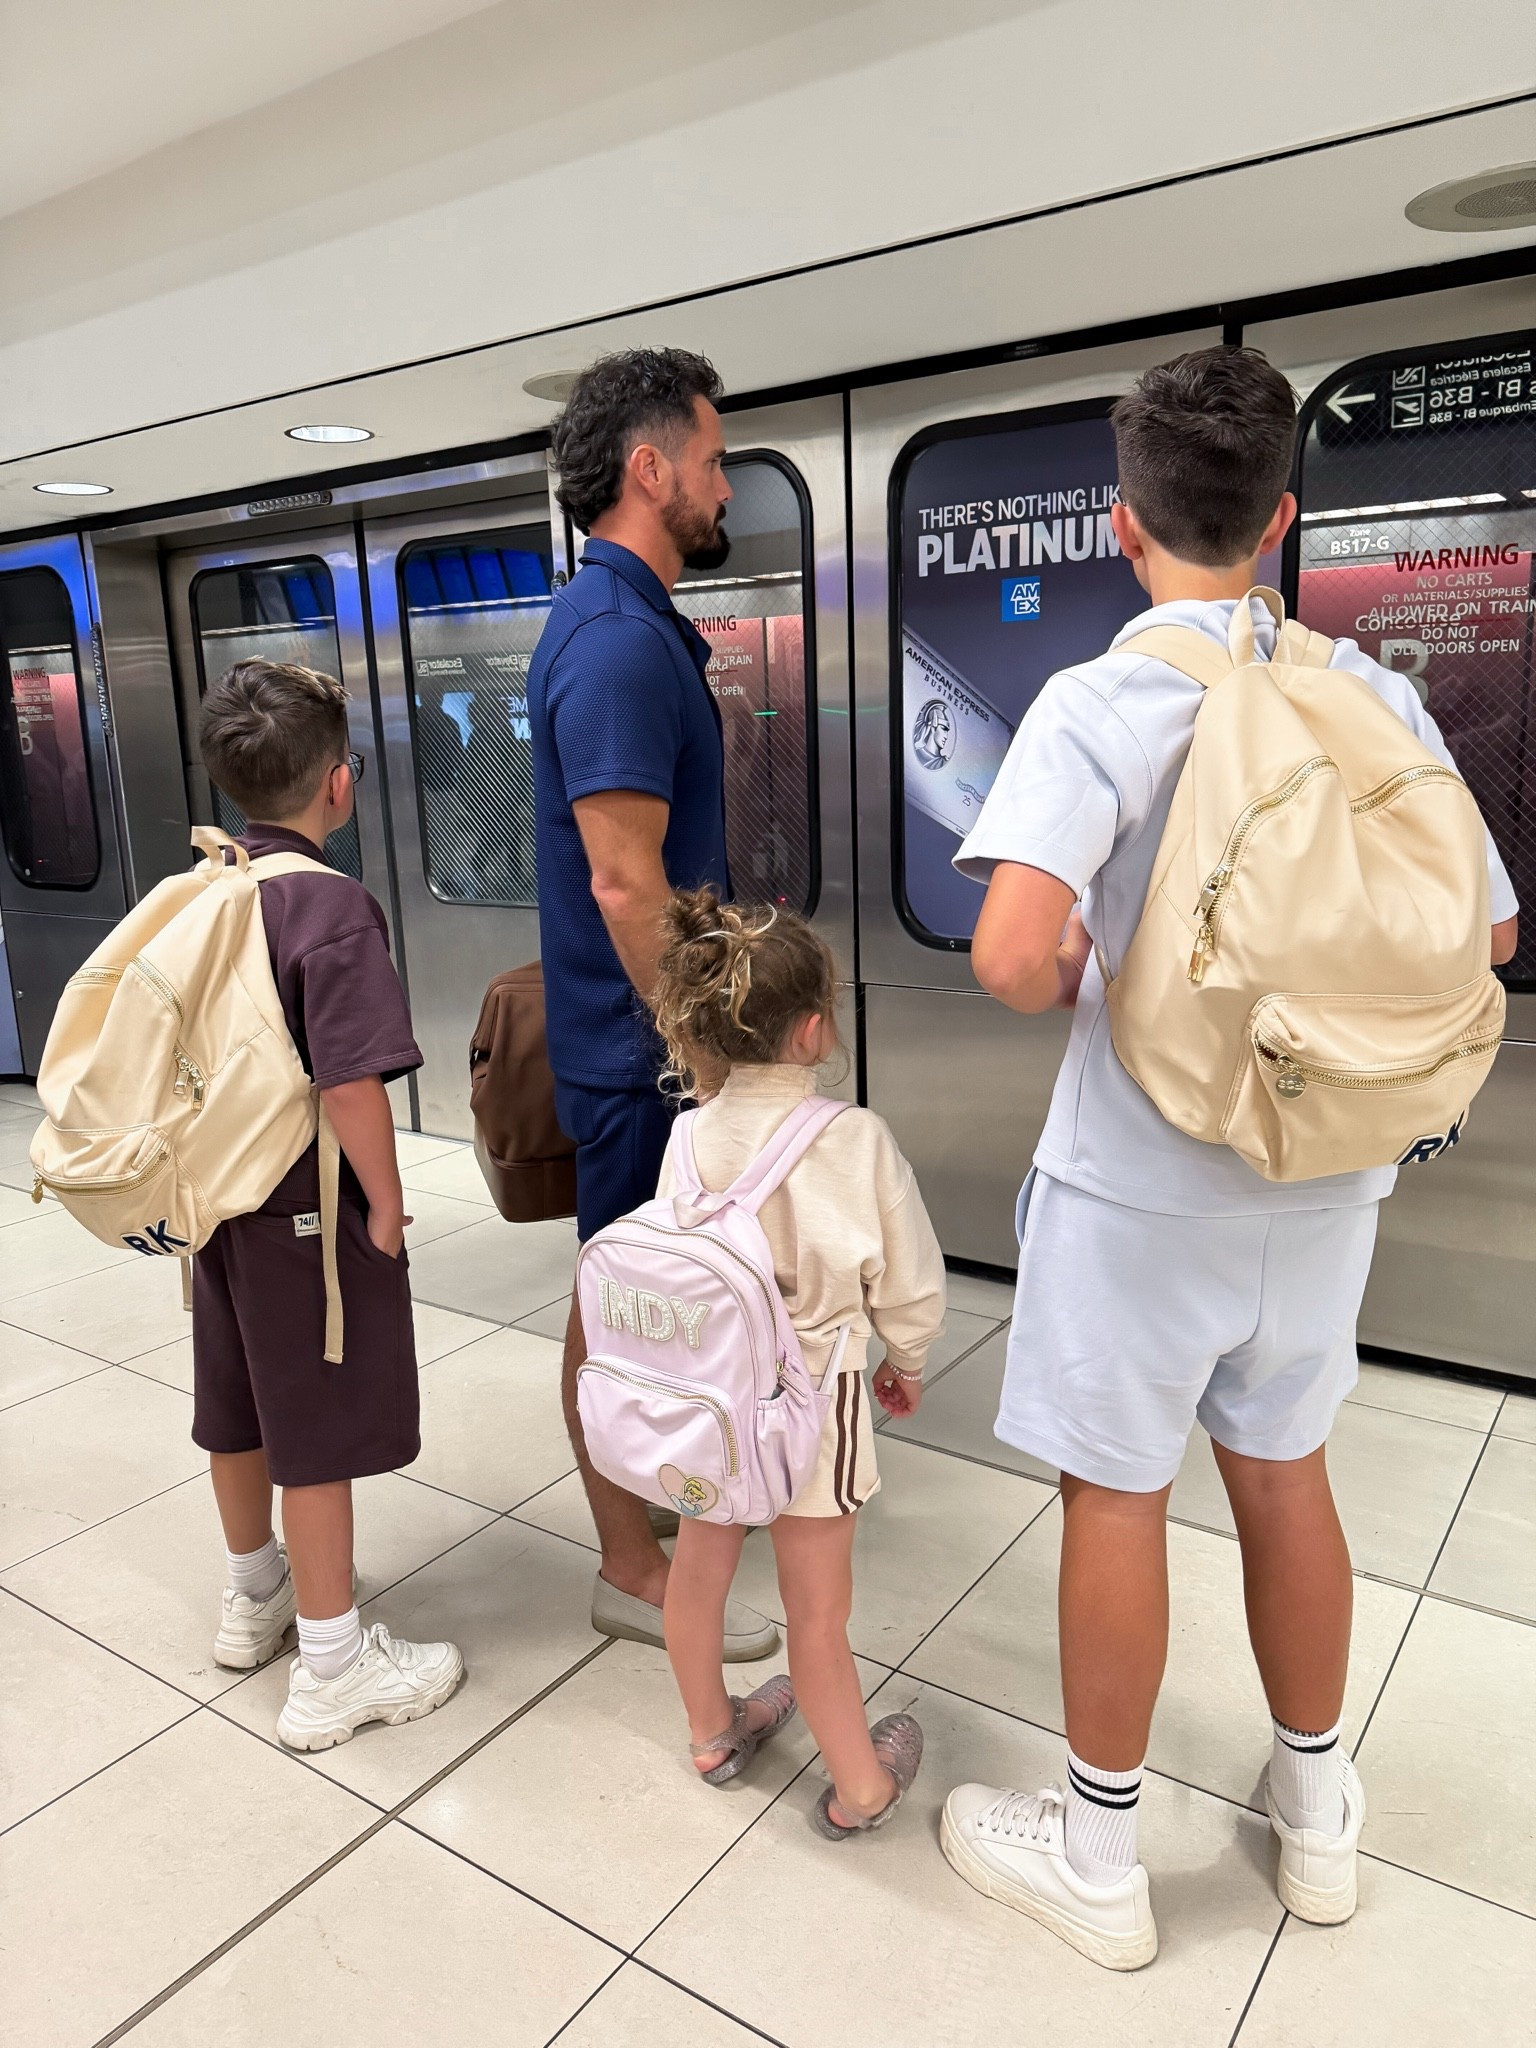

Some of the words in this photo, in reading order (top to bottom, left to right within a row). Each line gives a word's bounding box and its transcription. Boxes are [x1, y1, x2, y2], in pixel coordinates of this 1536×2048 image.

[919, 500, 994, 530] THERE'S
[998, 489, 1086, 521] NOTHING
[1092, 484, 1124, 508] LIK
[1330, 535, 1390, 555] BS17-G
[1394, 543, 1519, 572] WARNING
[1417, 576, 1438, 589] NO
[1446, 572, 1493, 587] CARTS
[1382, 593, 1398, 604] OR
[1368, 603, 1449, 621] ALLOWED
[1455, 602, 1481, 616] ON
[693, 615, 737, 634] RNING
[1421, 627, 1443, 640] DO
[1448, 625, 1479, 639] NOT
[1424, 641, 1475, 655] DOORS
[1480, 639, 1519, 652] OPEN
[724, 655, 753, 666] TRAIN
[13, 667, 46, 680] WARNING
[721, 686, 744, 696] OPEN
[905, 647, 953, 691] AMERICAN
[953, 687, 990, 723] EXPRESS
[924, 673, 970, 716] BUSINESS
[121, 1216, 192, 1256] RK
[598, 1275, 710, 1349] INDY
